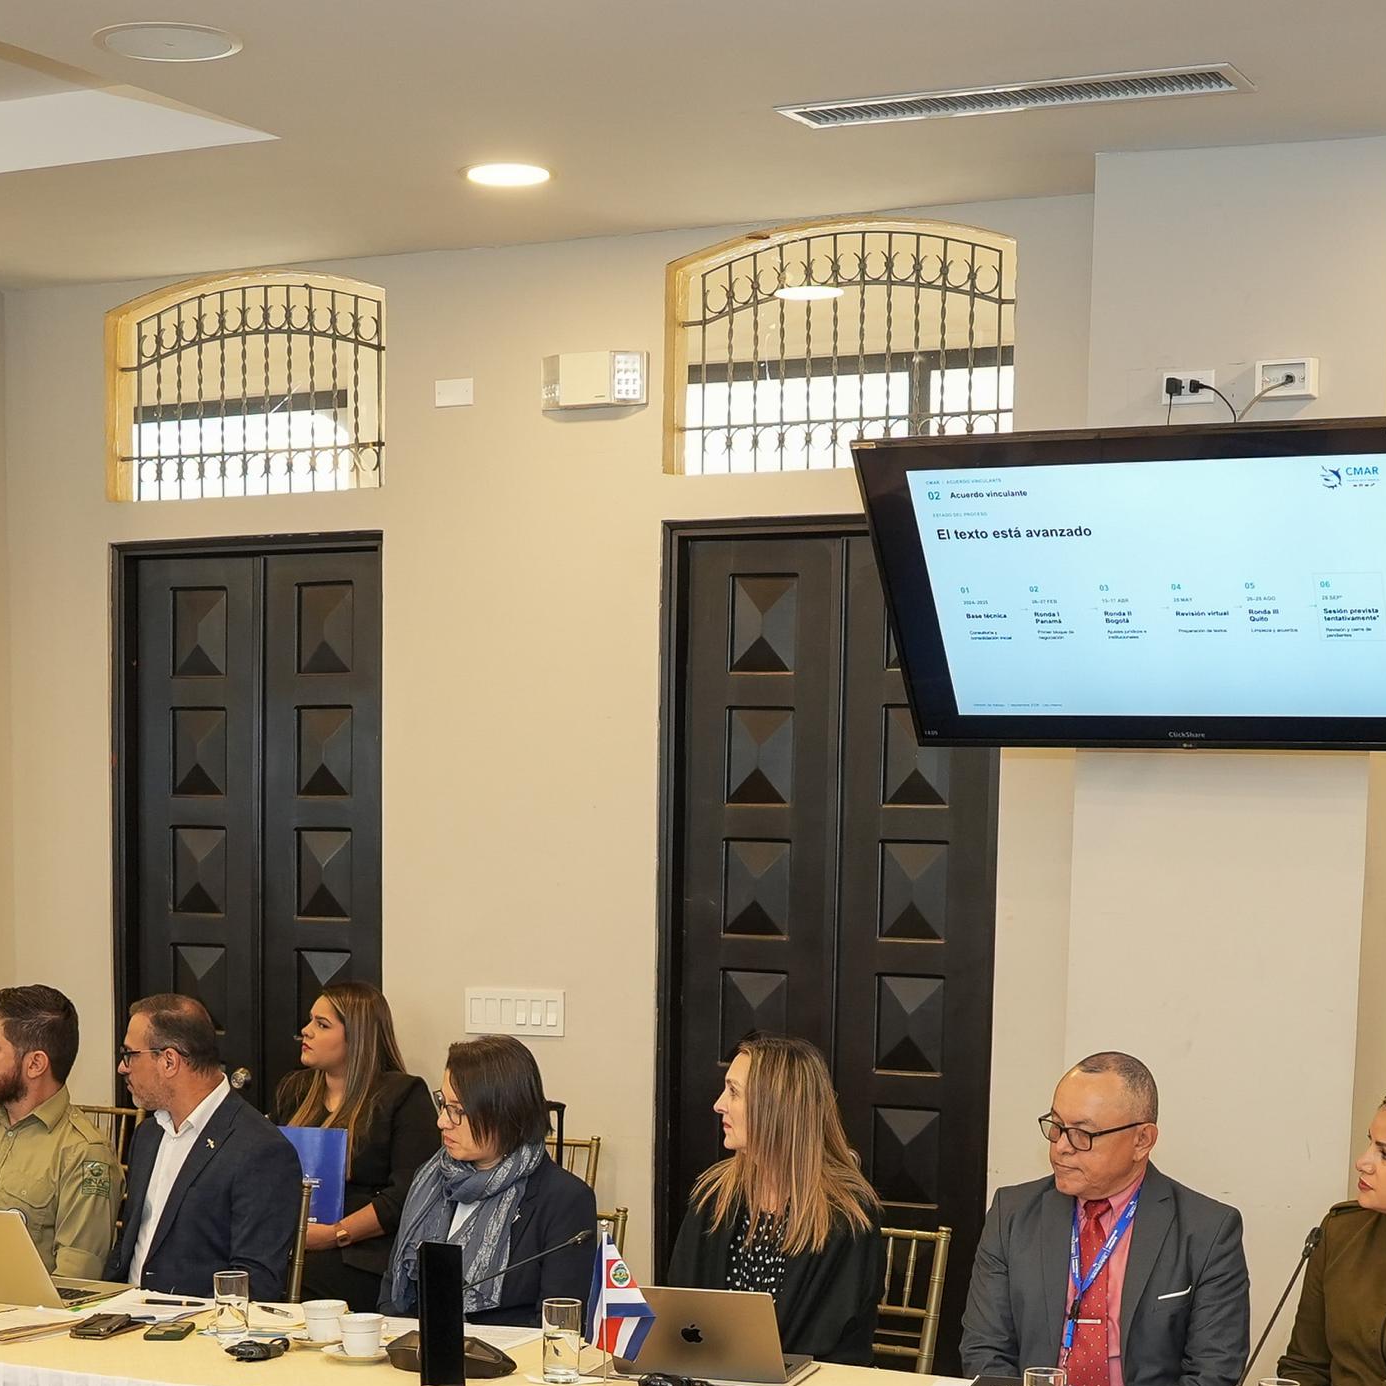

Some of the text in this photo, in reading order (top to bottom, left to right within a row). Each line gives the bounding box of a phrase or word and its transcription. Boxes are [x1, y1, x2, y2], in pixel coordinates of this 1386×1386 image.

[1345, 466, 1379, 476] CMAR
[927, 489, 1028, 500] 02 Acuerdo vinculante
[937, 525, 1092, 540] El texto está avanzado
[960, 586, 970, 594] 01
